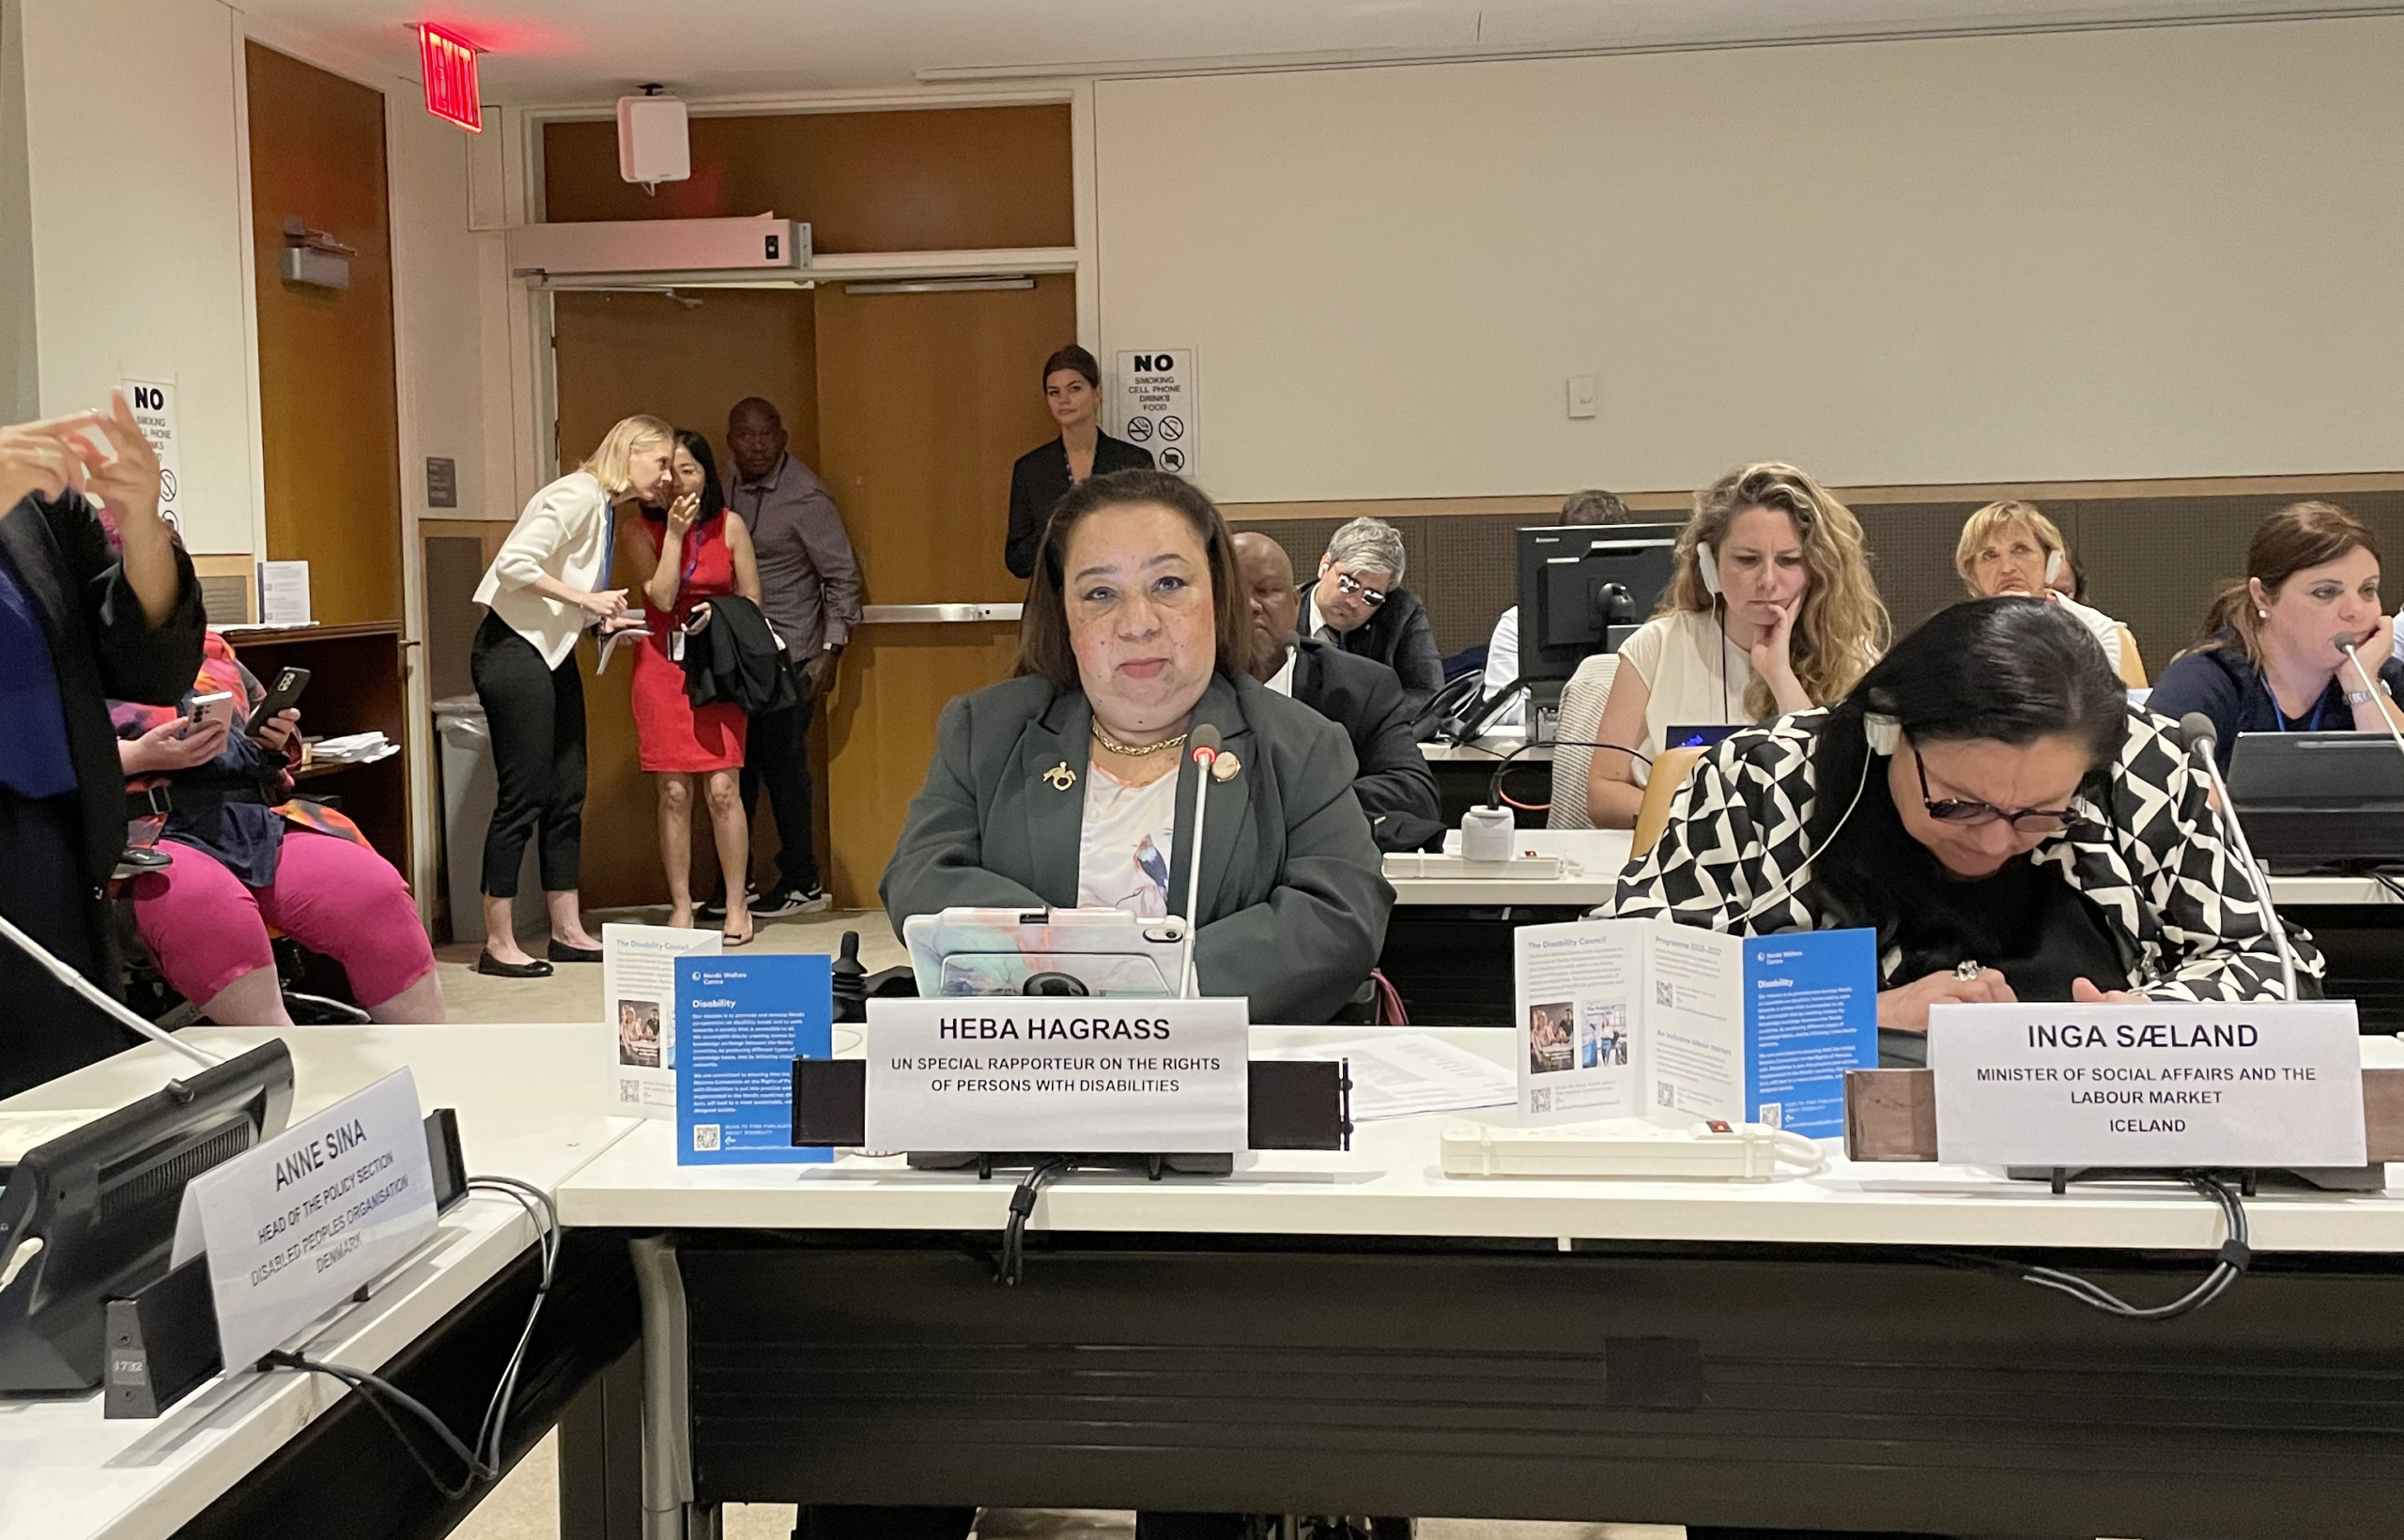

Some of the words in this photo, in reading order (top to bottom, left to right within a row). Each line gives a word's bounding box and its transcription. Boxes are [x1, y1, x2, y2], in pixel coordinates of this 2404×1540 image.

[429, 32, 474, 122] EXIT
[1134, 354, 1174, 372] NO
[134, 387, 163, 410] NO
[150, 430, 171, 439] PHONE
[631, 941, 662, 949] Disability
[1580, 936, 1607, 945] Council
[692, 998, 736, 1009] Disability
[940, 1018, 1020, 1040] HEBA
[1027, 1018, 1170, 1040] HAGRASS
[2028, 1024, 2108, 1049] INGA
[2117, 1024, 2258, 1048] SÆLAND
[891, 1057, 913, 1070] UN
[917, 1057, 984, 1070] SPECIAL
[988, 1057, 1095, 1070] RAPPORTEUR
[1100, 1057, 1122, 1070] ON
[1127, 1057, 1158, 1070] THE
[1163, 1057, 1221, 1070] RIGHTS
[1977, 1068, 2058, 1082] MINISTER
[2063, 1068, 2086, 1082] OF
[2091, 1068, 2156, 1082] SOCIAL
[2161, 1068, 2234, 1081] AFFAIRS
[2239, 1067, 2276, 1081] AND
[2281, 1068, 2317, 1081] THE
[931, 1079, 952, 1092] OF
[957, 1079, 1031, 1092] PERSONS
[1036, 1079, 1075, 1092] WITH
[1080, 1079, 1179, 1092] DISABILITIES
[2071, 1090, 2144, 1104] LABOUR
[2149, 1090, 2223, 1104] MARKET
[2109, 1119, 2186, 1132] ICELAND
[275, 1141, 324, 1192] ANNE
[327, 1118, 367, 1160] SINA
[257, 1217, 285, 1244] HEAD
[288, 1207, 301, 1225] OF
[302, 1193, 322, 1217] THE
[324, 1175, 355, 1205] POLICY
[357, 1150, 393, 1183] SECTION
[251, 1243, 301, 1286] DISABLED
[302, 1215, 346, 1254] PEOPLES
[347, 1175, 408, 1224] ORGANISATION
[316, 1231, 362, 1273] DENMARK
[115, 1361, 143, 1371] 1732
